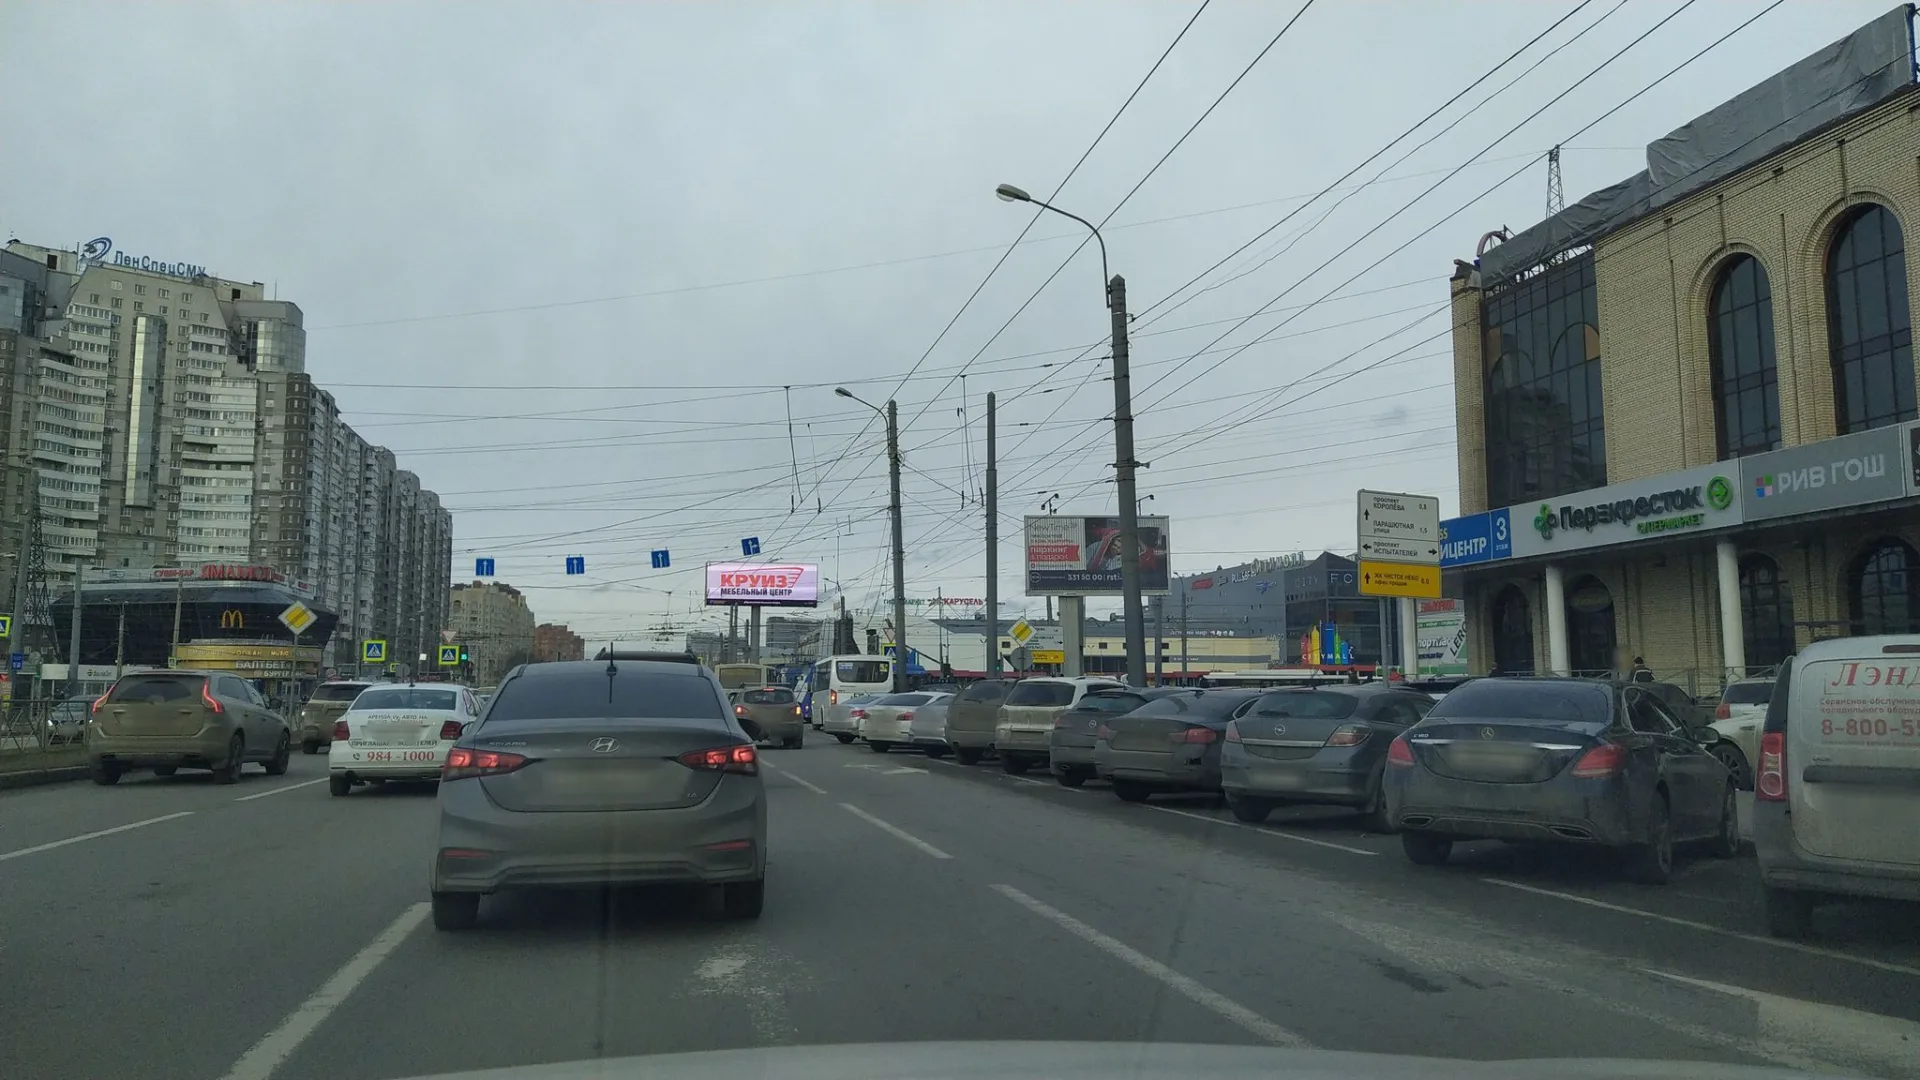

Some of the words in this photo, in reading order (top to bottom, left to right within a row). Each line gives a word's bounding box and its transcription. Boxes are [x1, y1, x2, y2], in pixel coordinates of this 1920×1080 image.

[114, 250, 206, 277] ЛенСпецСМУ
[1777, 465, 1826, 494] РИВ
[1831, 453, 1885, 484] ГОШ
[1373, 502, 1405, 511] КОРОЛЁВА
[1373, 520, 1415, 530] ПАРАШЮТНАЯ
[1496, 516, 1507, 541] 3
[1373, 547, 1418, 556] ИСПЫТАТЕЛЕЙ
[720, 574, 788, 588] КРУИЗ
[1067, 573, 1080, 581] 331
[1092, 573, 1102, 581] 00
[720, 588, 768, 597] МЕБЕЛЬНЫЙ
[769, 588, 793, 597] ЦЕНТР
[236, 660, 285, 669] БАЛТБЕТ
[1820, 697, 1867, 706] Сервисное
